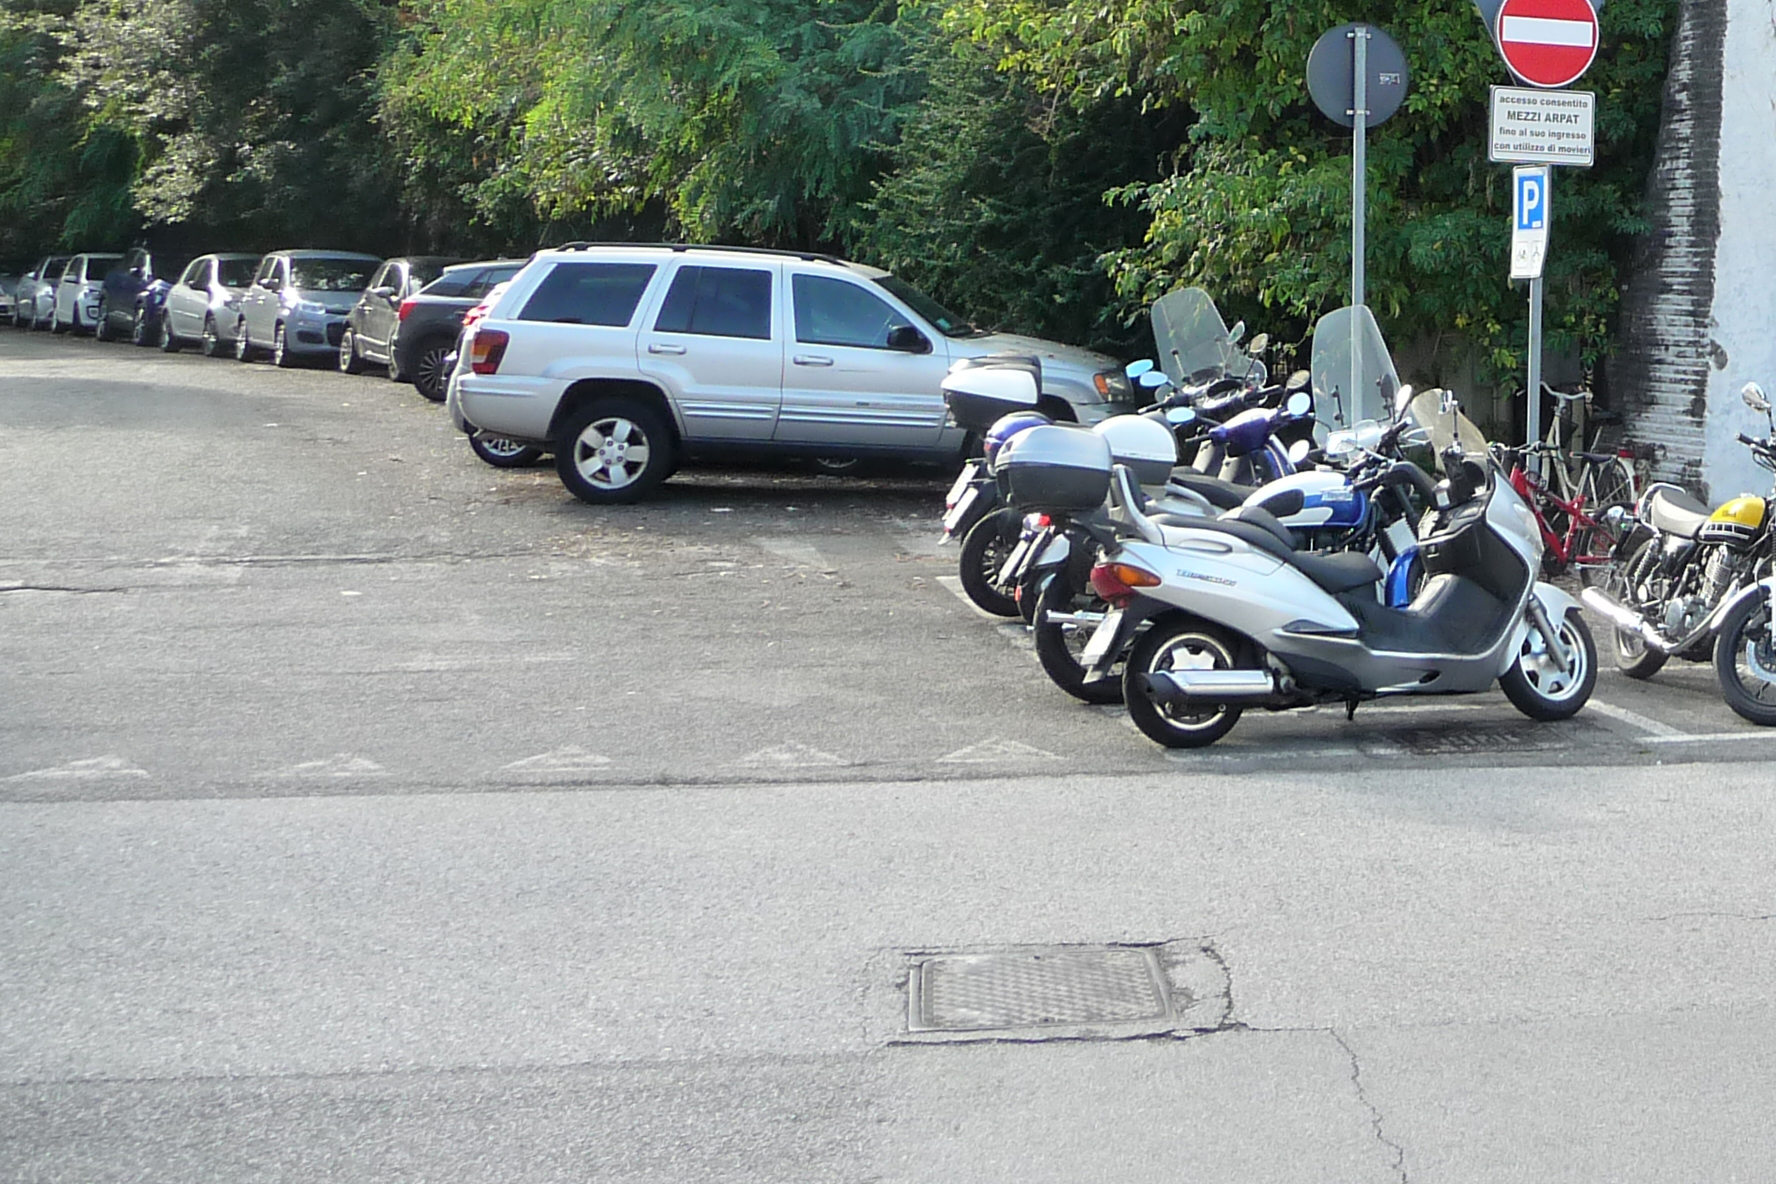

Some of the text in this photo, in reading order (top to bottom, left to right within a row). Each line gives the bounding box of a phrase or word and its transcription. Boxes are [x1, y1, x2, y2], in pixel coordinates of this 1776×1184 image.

[1500, 96, 1588, 108] accesso consentito
[1507, 110, 1580, 124] MEZZI ARPAT
[1499, 127, 1587, 140] fino al suo ingresso
[1494, 142, 1591, 154] con utilizzo di movieri
[1522, 180, 1540, 225] P
